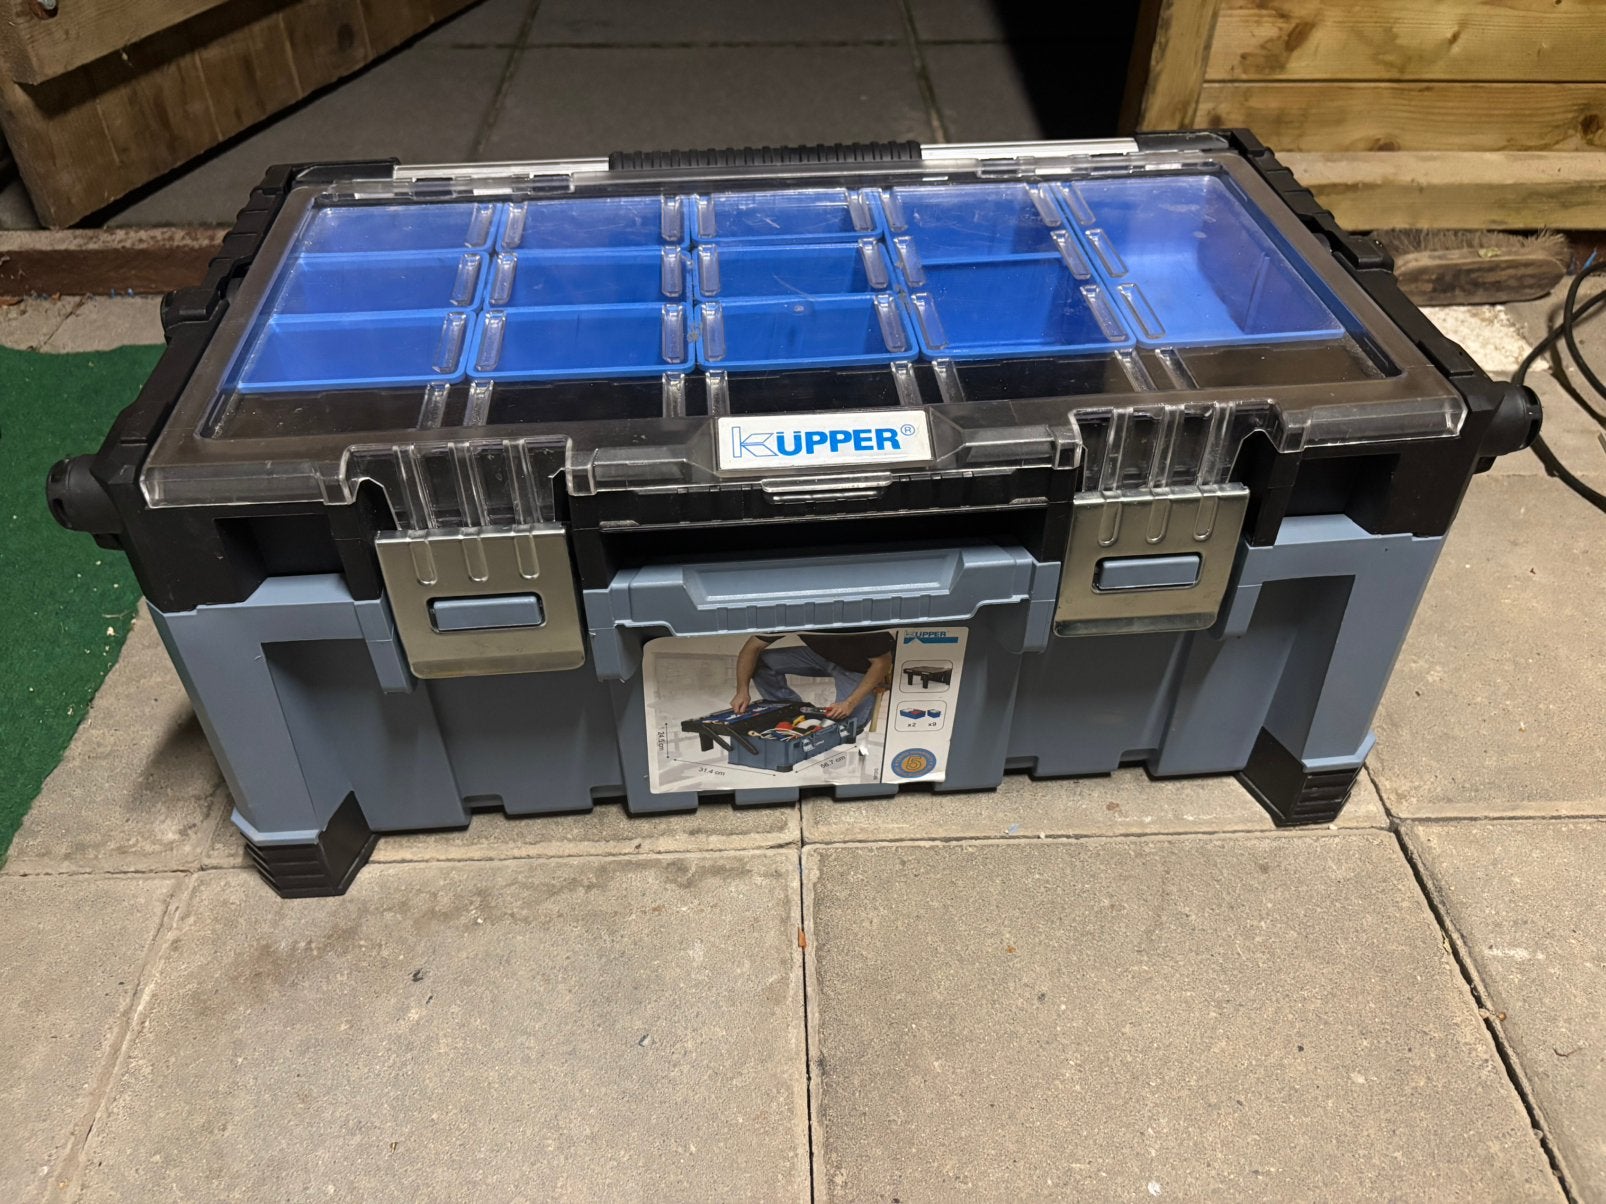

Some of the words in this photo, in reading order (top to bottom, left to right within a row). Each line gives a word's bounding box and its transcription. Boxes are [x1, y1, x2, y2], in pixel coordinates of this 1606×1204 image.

[835, 755, 847, 763] cm
[906, 756, 922, 771] 5
[698, 766, 714, 774] 31.4
